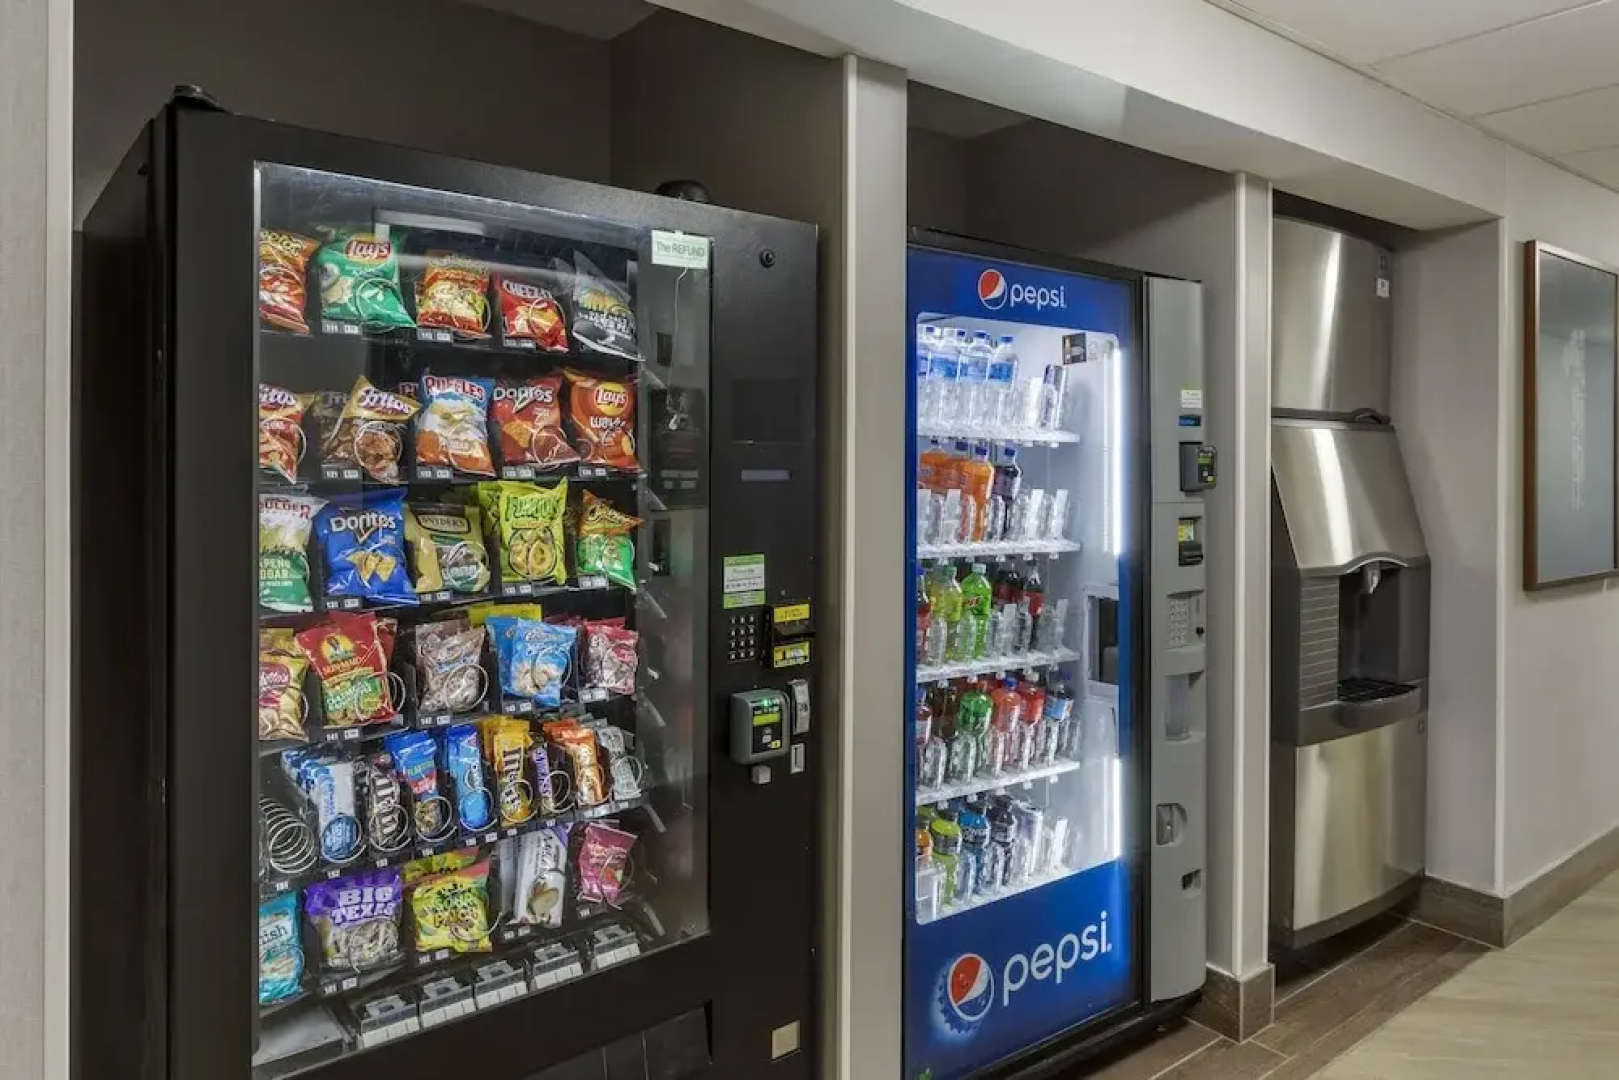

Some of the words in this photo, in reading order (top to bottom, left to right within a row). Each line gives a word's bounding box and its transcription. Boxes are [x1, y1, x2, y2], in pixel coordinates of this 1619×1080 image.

[671, 242, 705, 257] REFUND
[1010, 284, 1067, 310] pepsi
[422, 374, 485, 402] RUFFLES
[492, 385, 553, 404] Doritos
[330, 510, 396, 532] Doritos
[339, 886, 394, 906] BIG
[331, 900, 395, 925] TEXAS
[1002, 910, 1107, 1008] pepsi
